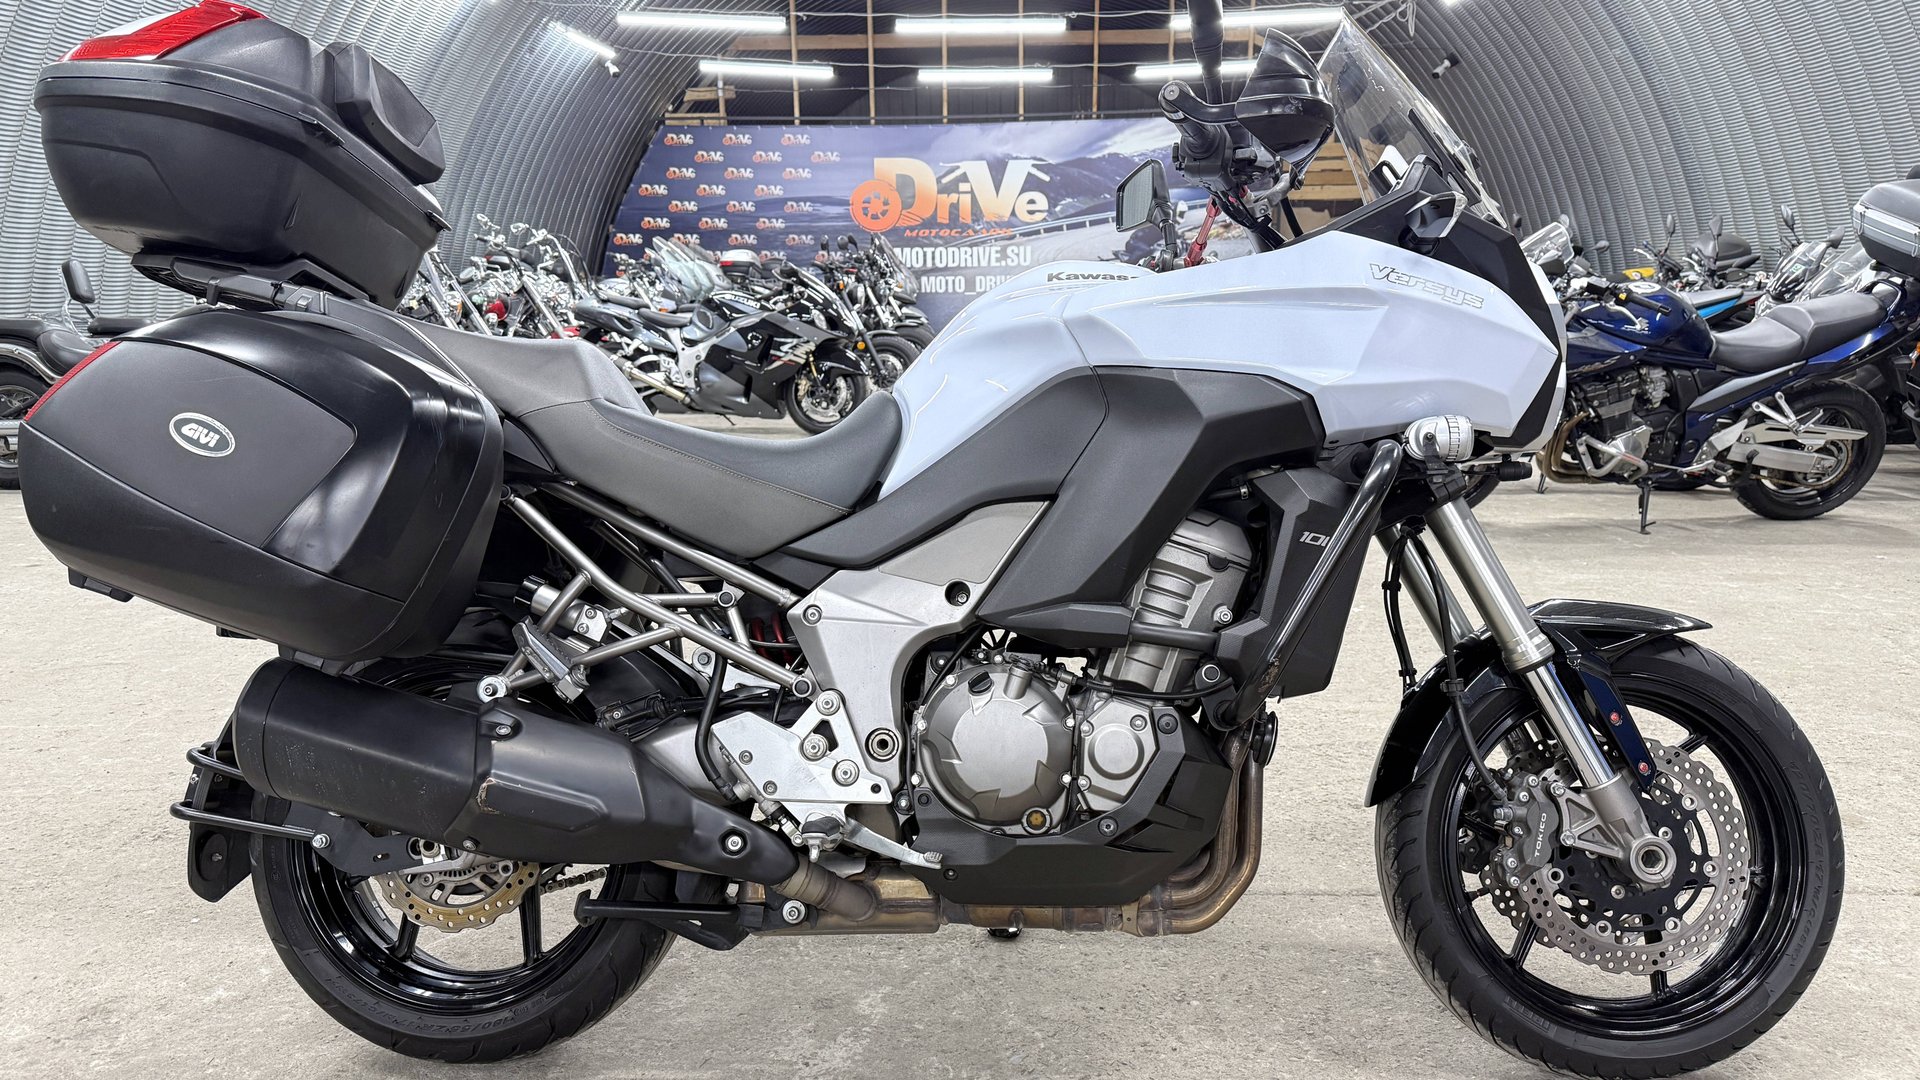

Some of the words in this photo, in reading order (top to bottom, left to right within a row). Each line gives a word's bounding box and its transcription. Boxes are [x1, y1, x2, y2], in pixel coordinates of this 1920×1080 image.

[893, 246, 1031, 268] MOTODRIVE.SU
[1047, 271, 1139, 283] Kawas
[1369, 263, 1485, 309] Versys
[181, 422, 221, 448] GIVI
[1534, 812, 1547, 858] TOKICO
